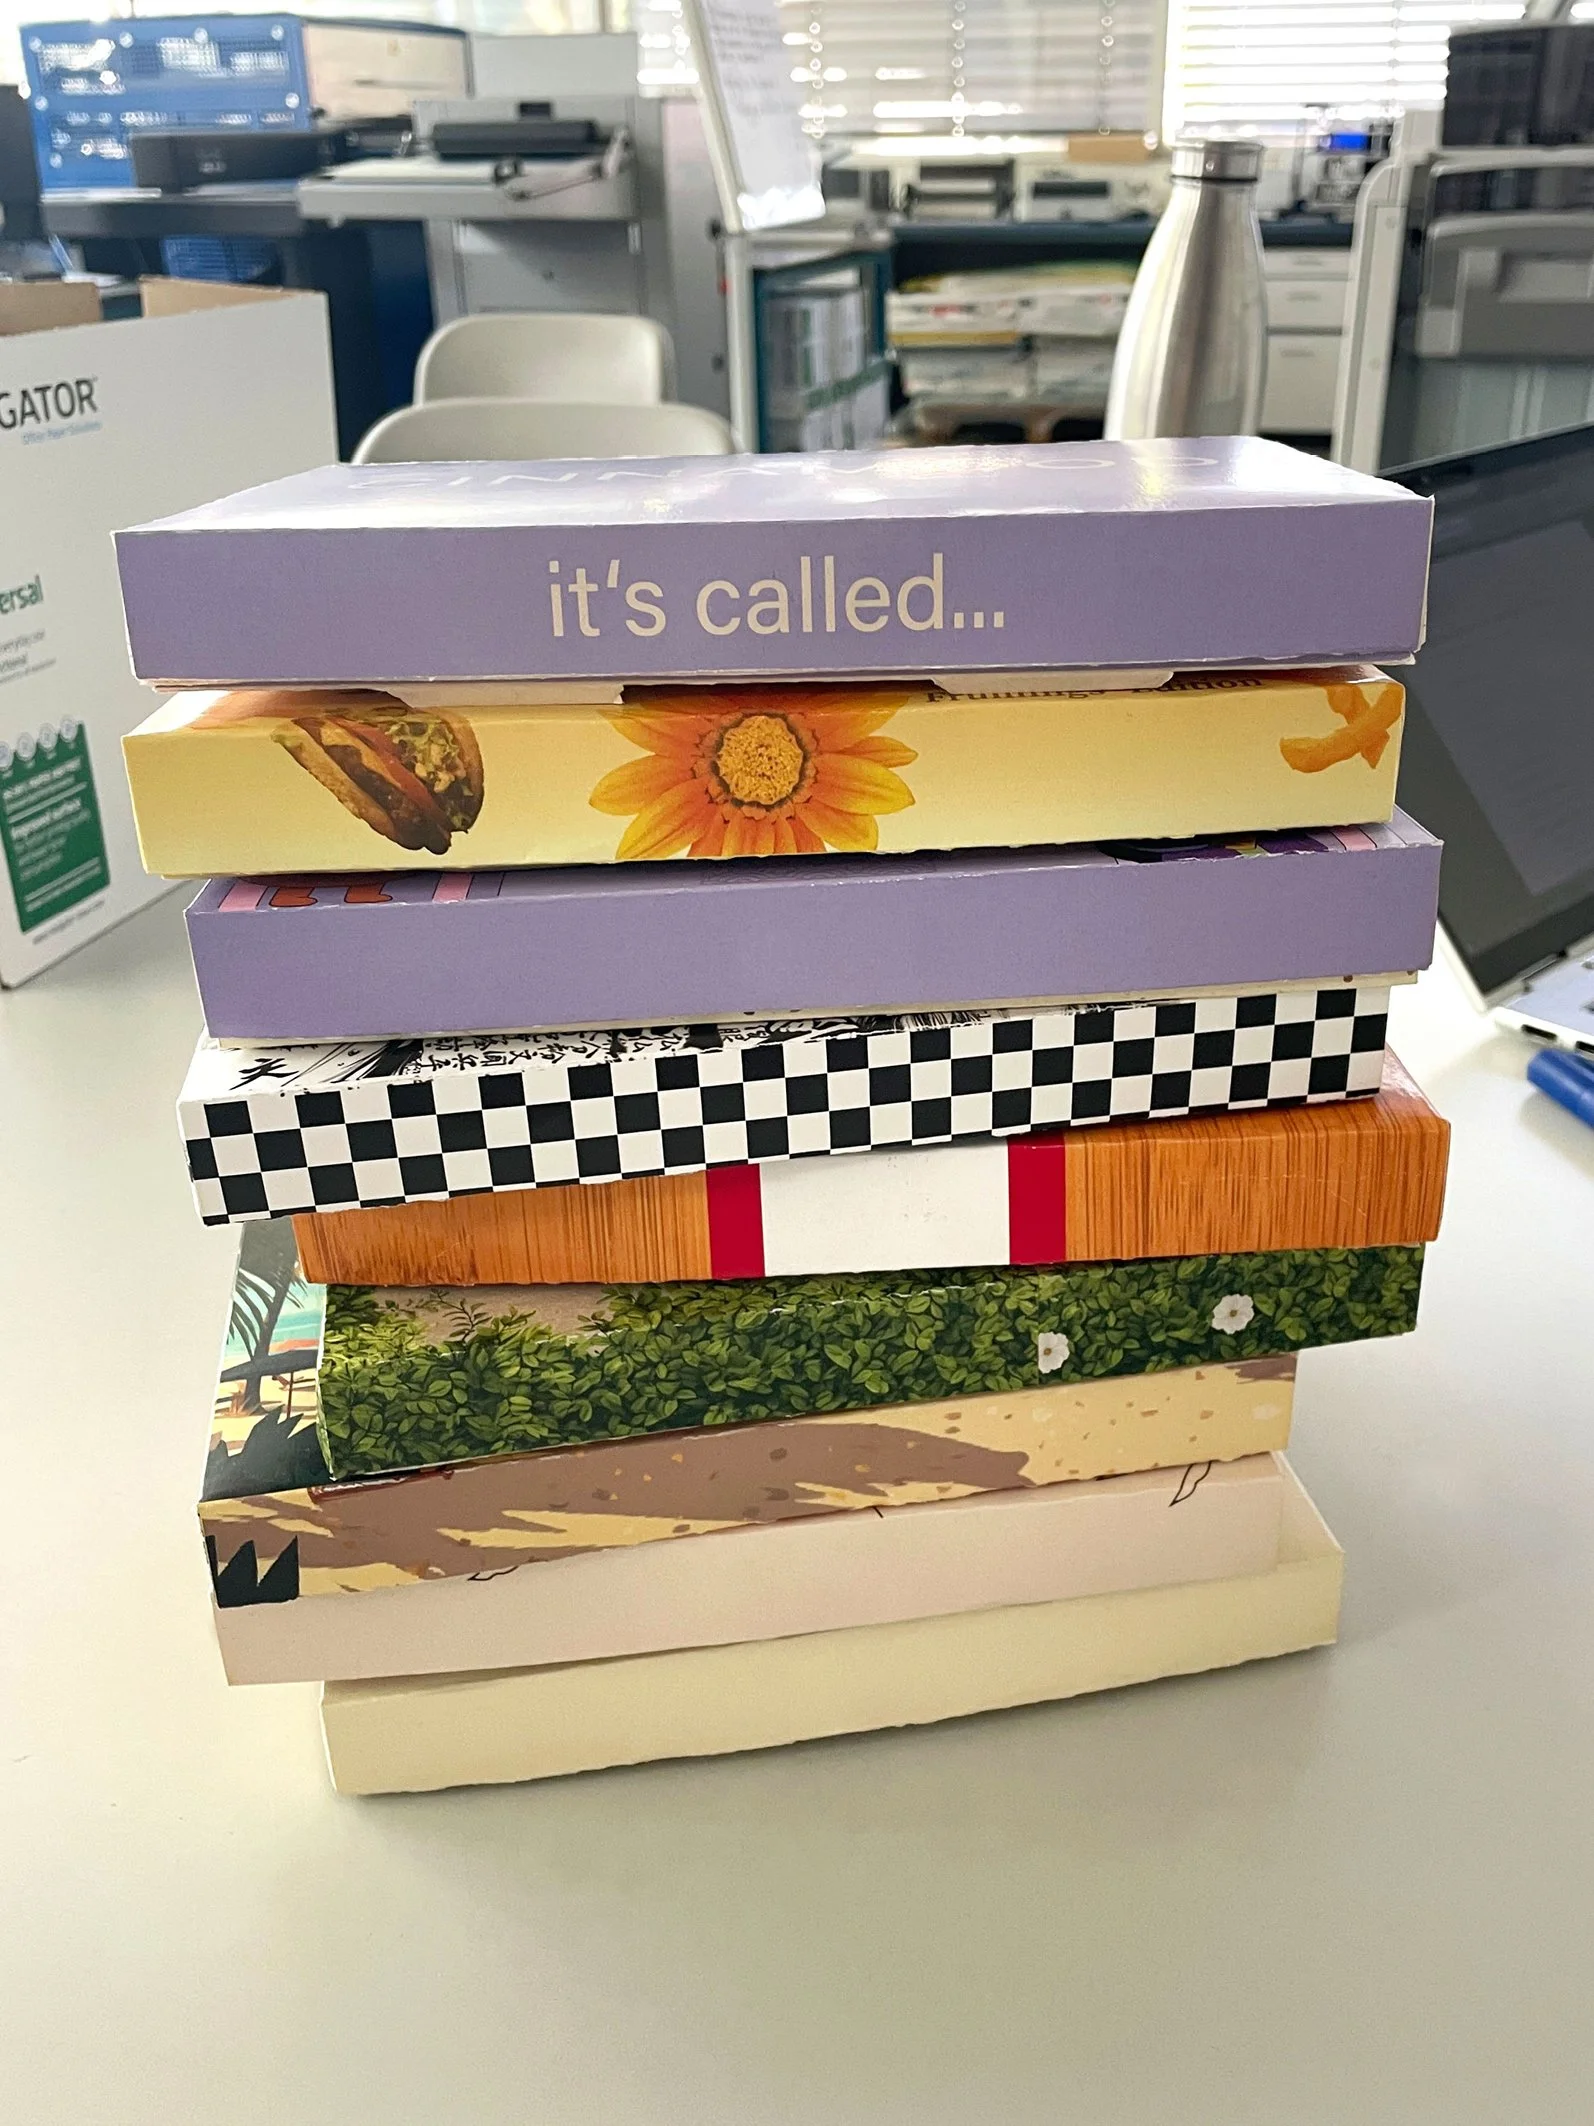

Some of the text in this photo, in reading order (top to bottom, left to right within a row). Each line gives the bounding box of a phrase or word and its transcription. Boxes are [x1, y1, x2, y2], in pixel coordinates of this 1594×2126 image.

[347, 455, 1204, 489] CINNAMOD
[549, 553, 1007, 637] it's called...
